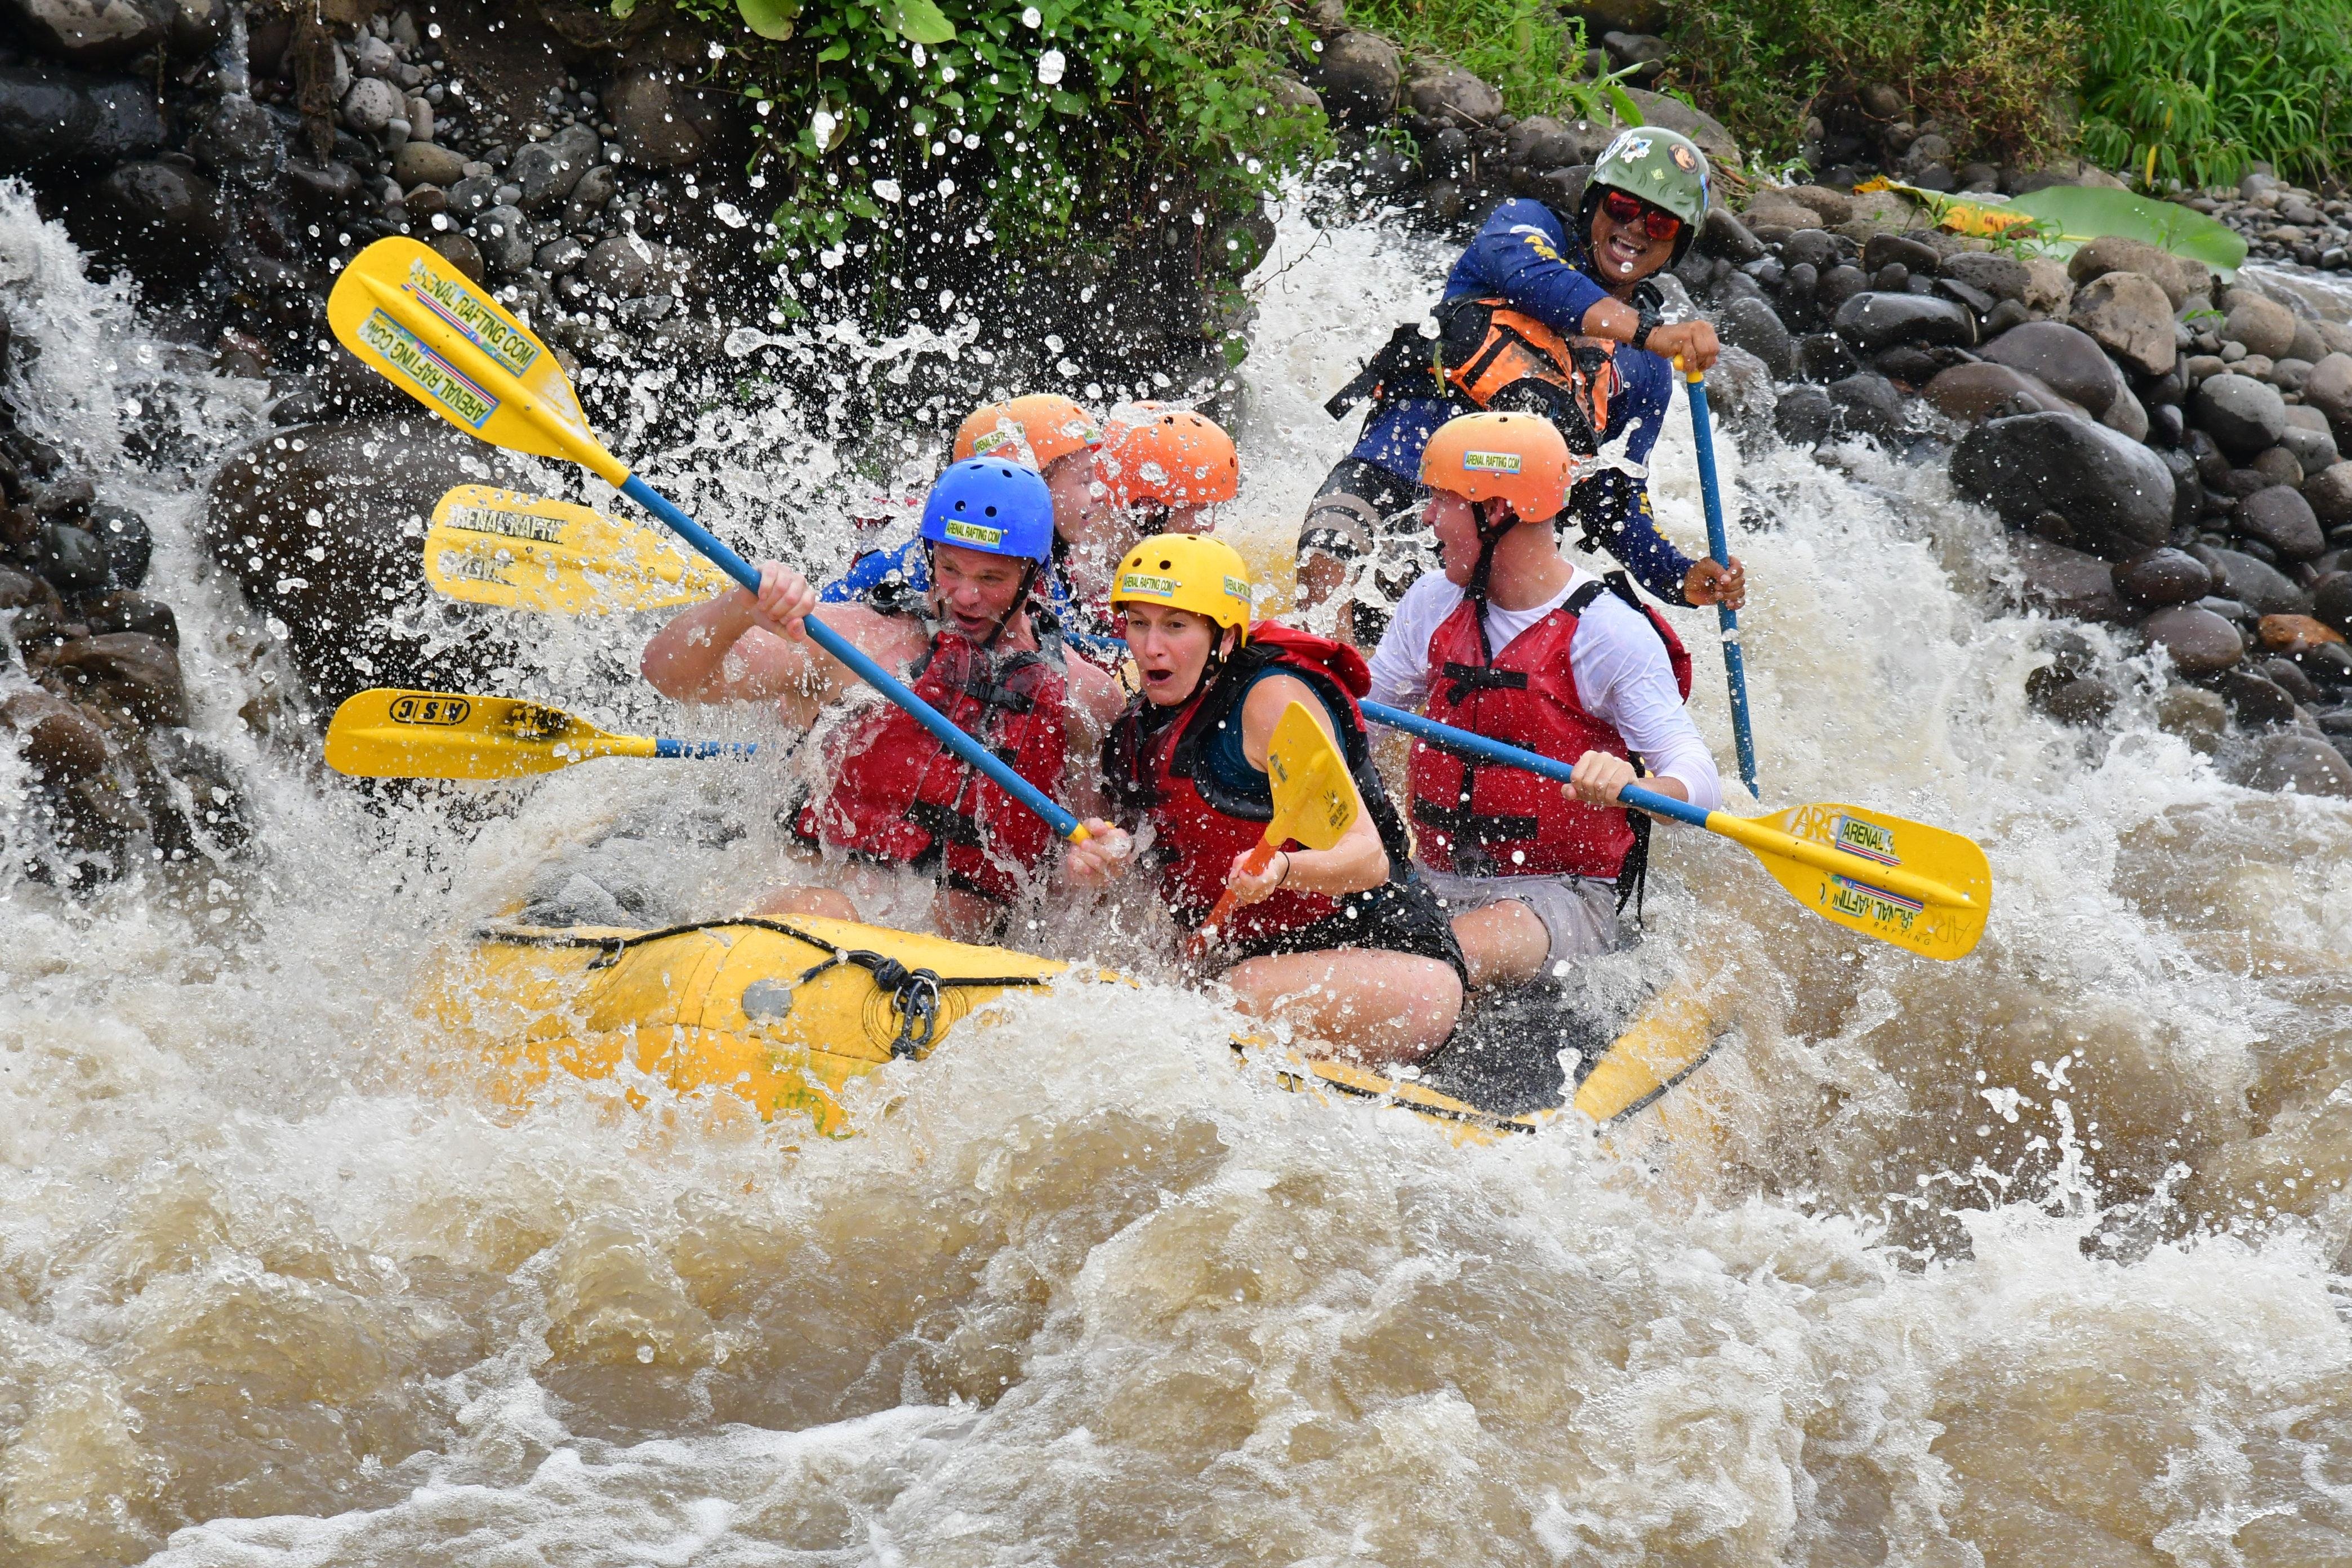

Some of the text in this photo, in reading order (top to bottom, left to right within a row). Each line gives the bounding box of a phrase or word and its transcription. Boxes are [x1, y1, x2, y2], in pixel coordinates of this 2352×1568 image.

[439, 379, 488, 422] ARENAL
[1519, 387, 1549, 411] SPS
[1466, 455, 1485, 465] ARENAL
[446, 506, 506, 533] RENAL
[946, 522, 964, 536] ARENAL
[1124, 576, 1139, 587] ARENAL
[1842, 822, 1883, 850] ARENAL
[1874, 921, 1931, 946] RAFTING
